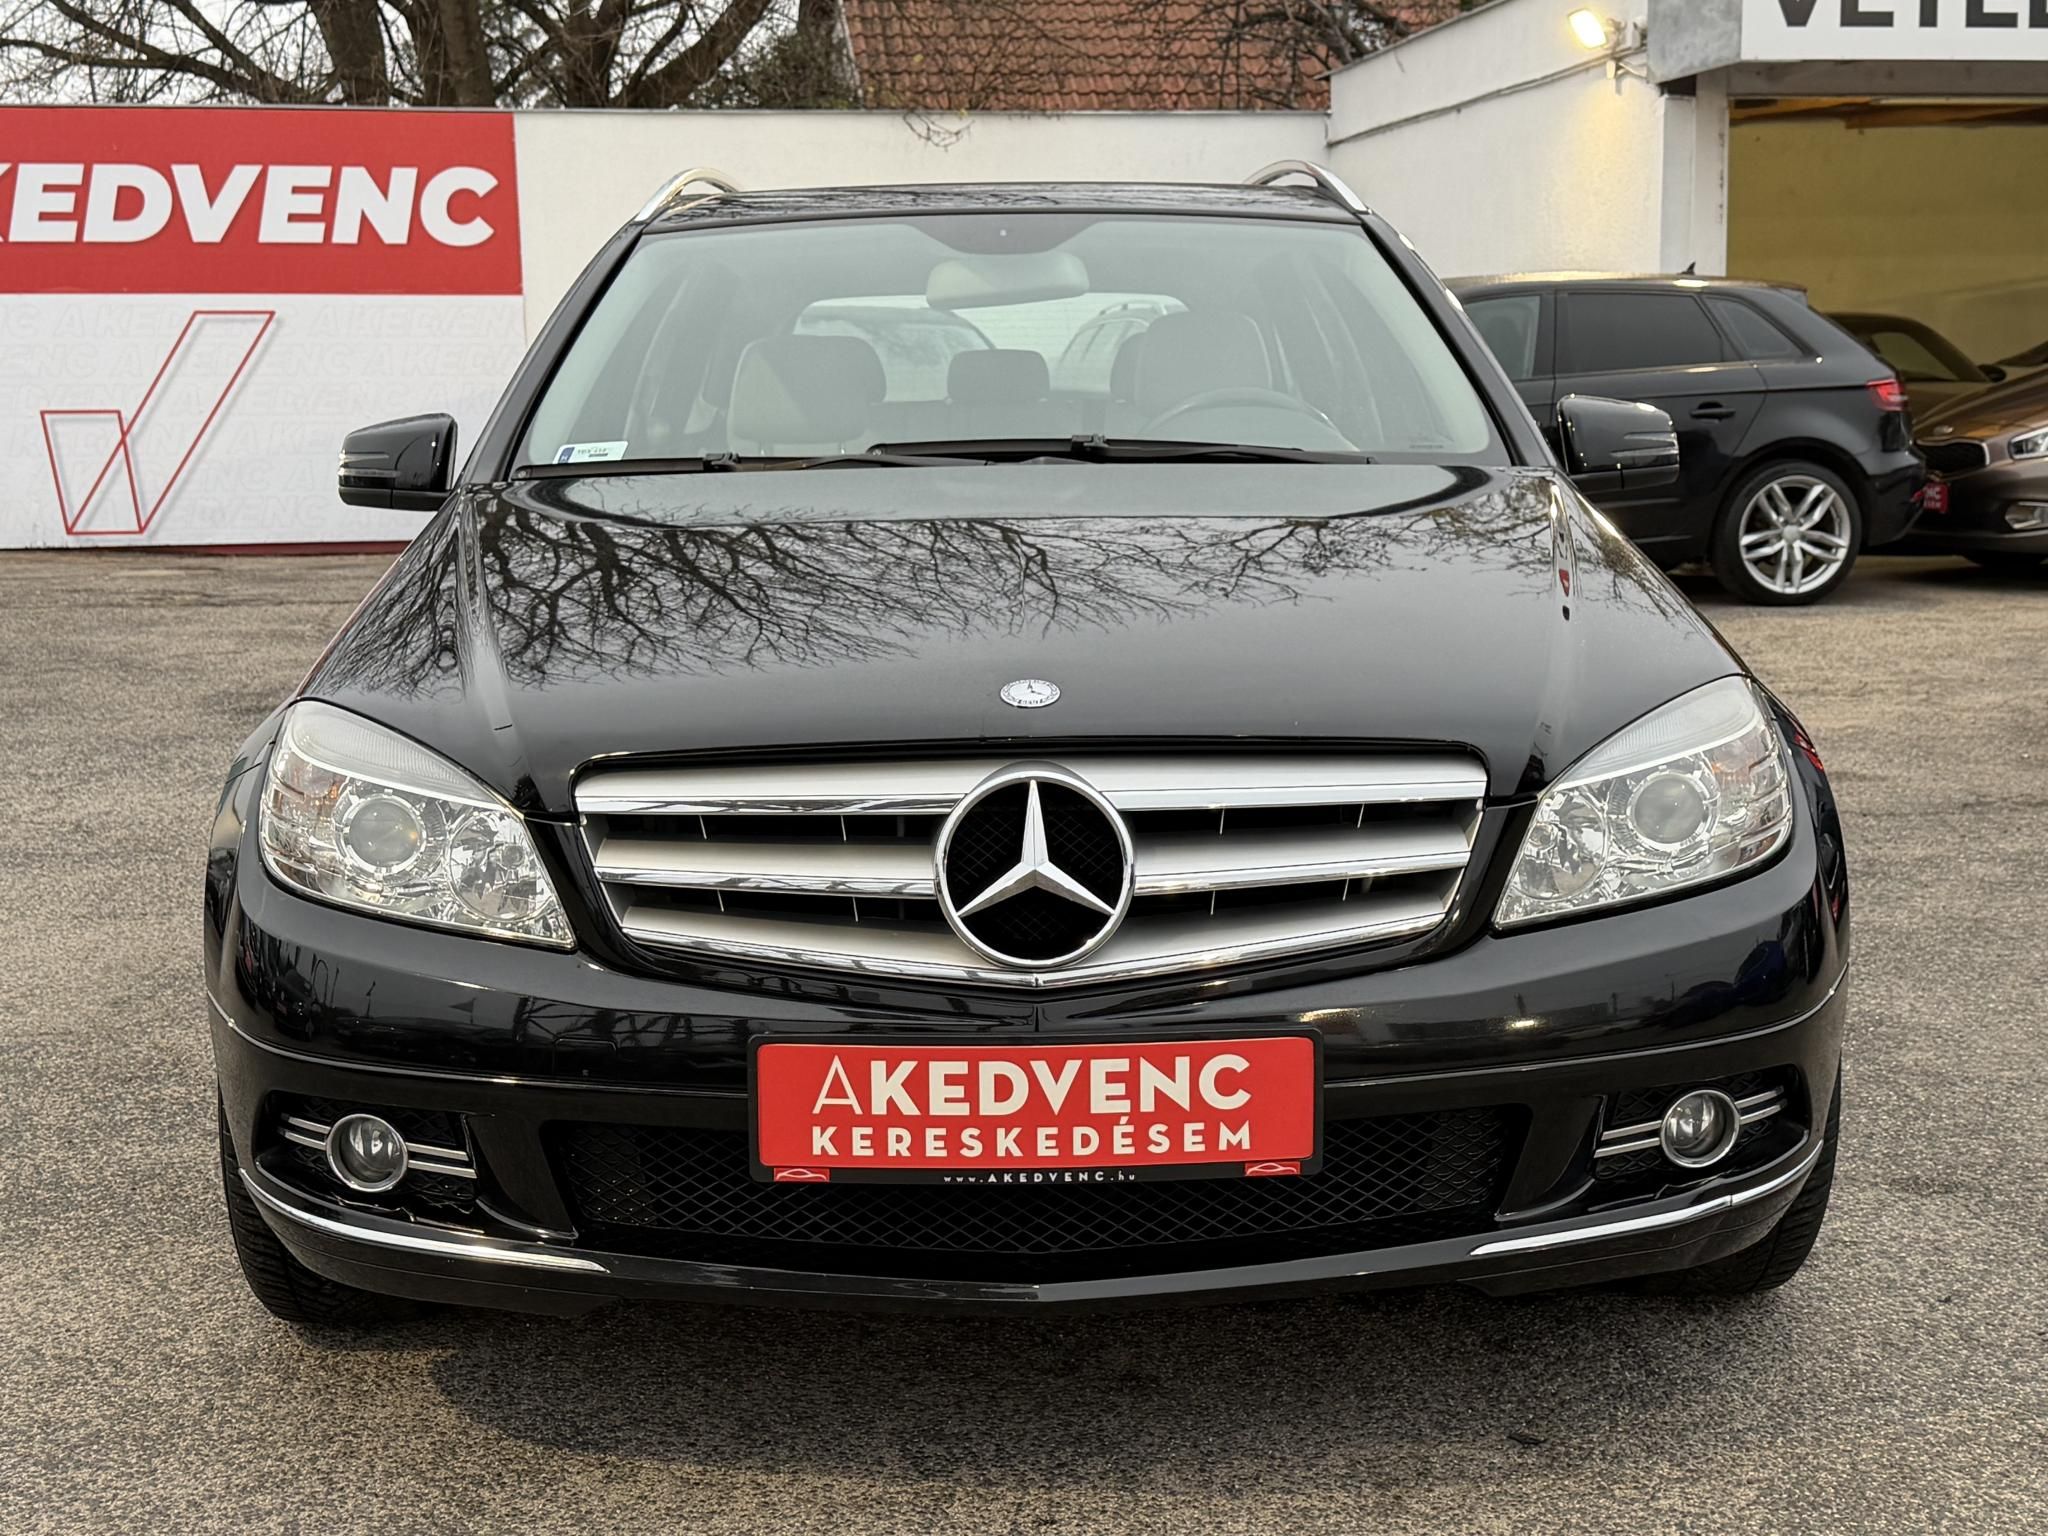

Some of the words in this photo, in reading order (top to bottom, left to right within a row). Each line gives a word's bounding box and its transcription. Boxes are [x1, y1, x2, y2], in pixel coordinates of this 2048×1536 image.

[0, 163, 498, 247] EDVENC
[812, 1053, 1252, 1116] AKEDVENC
[812, 1115, 1252, 1158] KERESKEDÉSEM
[943, 1170, 1136, 1183] www.AKEDVENC.hu
